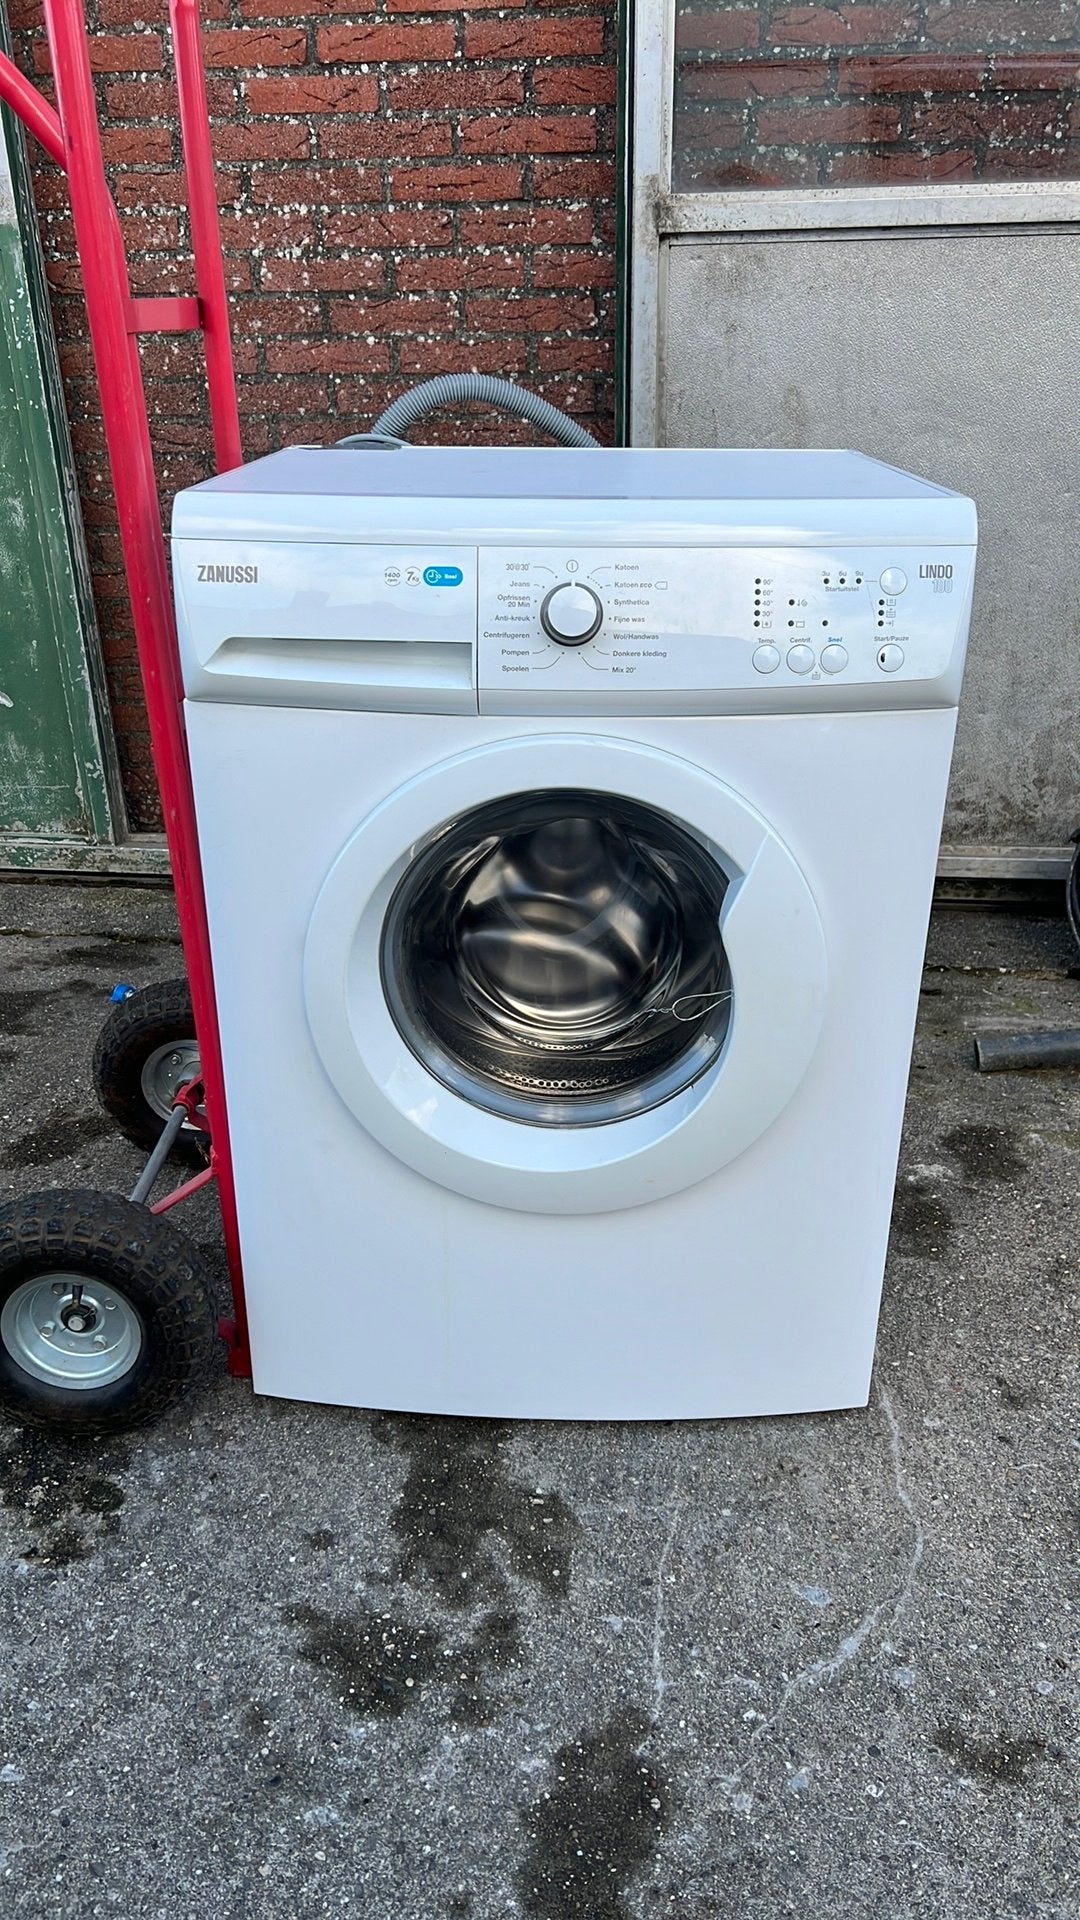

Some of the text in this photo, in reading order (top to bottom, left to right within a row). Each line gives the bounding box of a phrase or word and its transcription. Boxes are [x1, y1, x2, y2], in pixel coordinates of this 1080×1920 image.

[197, 565, 258, 584] ZANUSSI
[919, 564, 953, 579] LINDO
[497, 594, 530, 602] Opfrissen
[614, 598, 650, 606] Synthetica
[614, 616, 630, 624] Fijne
[483, 631, 530, 640] Centrifugeren
[642, 650, 668, 658] kleding
[501, 664, 530, 672] Spoelen
